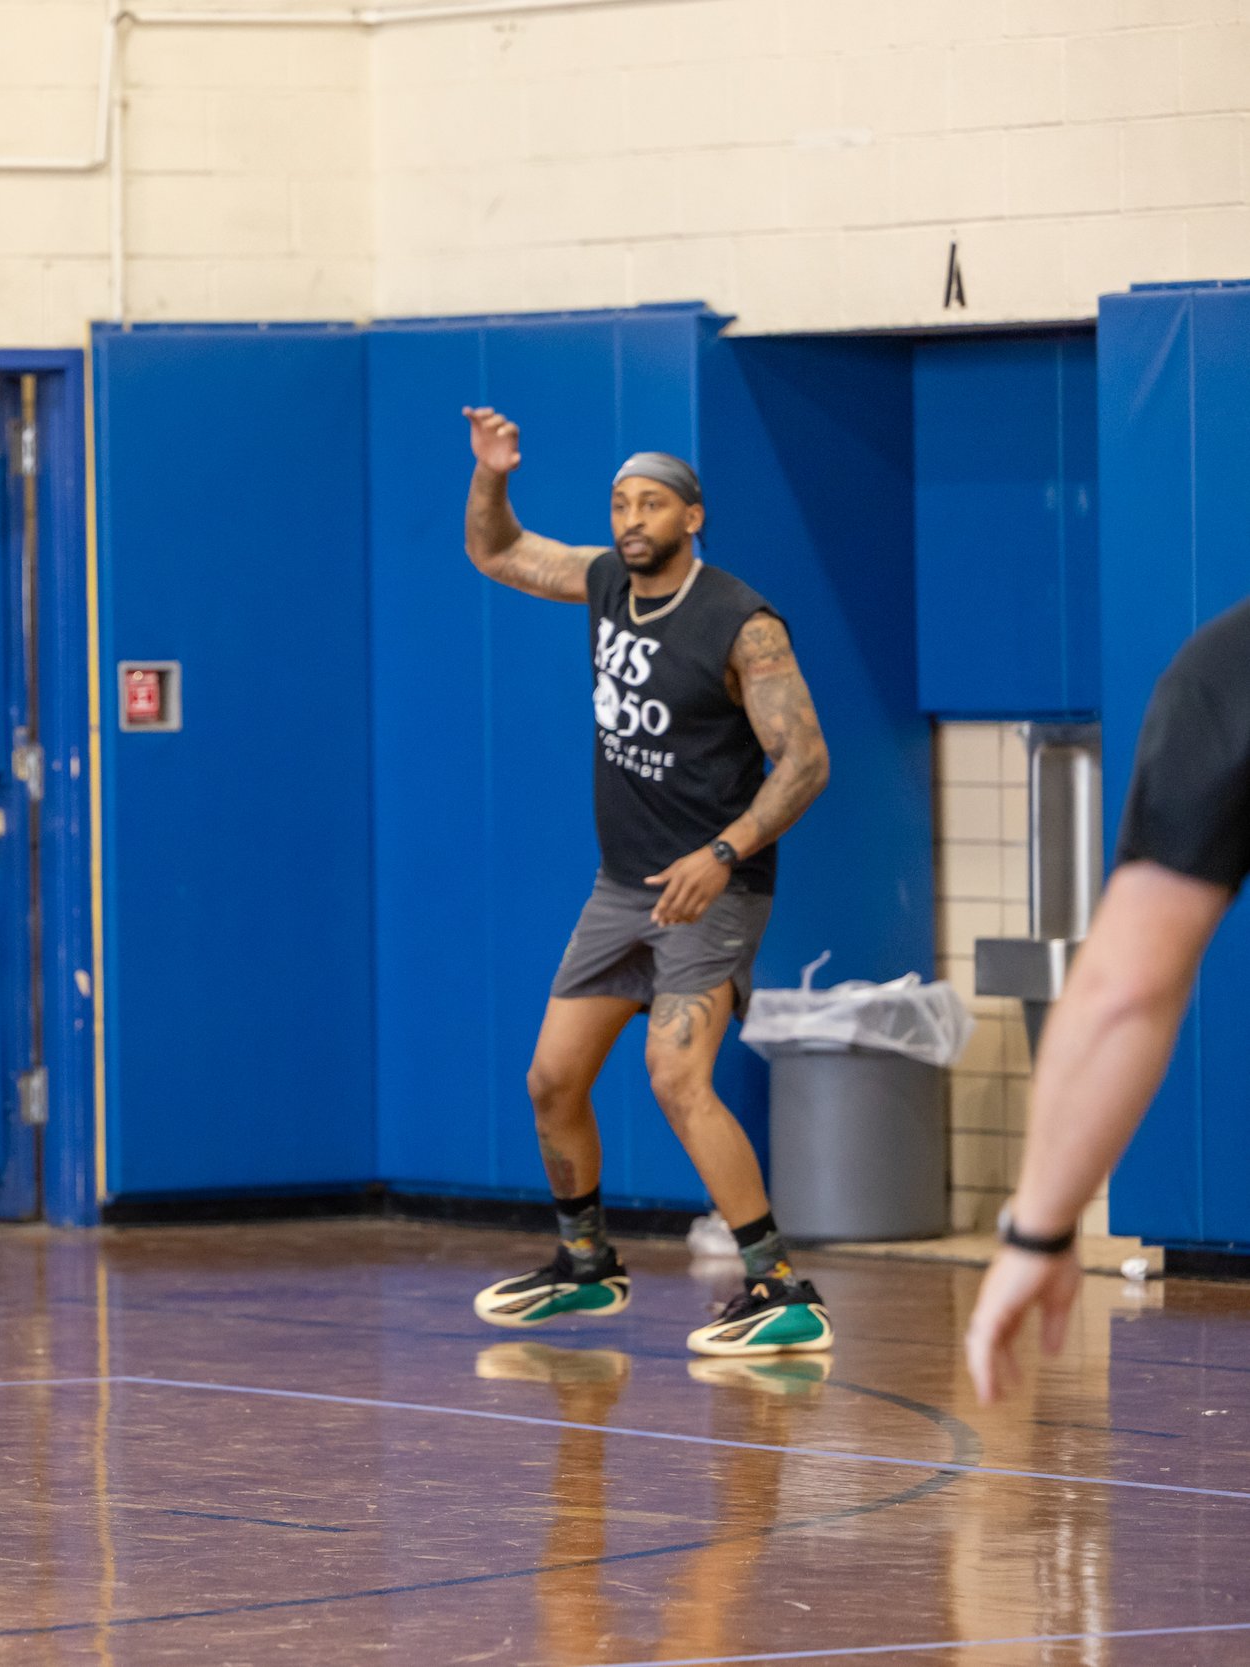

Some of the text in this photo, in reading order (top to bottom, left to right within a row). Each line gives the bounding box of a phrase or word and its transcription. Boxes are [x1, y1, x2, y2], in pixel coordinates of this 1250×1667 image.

[594, 617, 662, 687] MS
[616, 690, 671, 737] 50
[640, 749, 675, 768] THE
